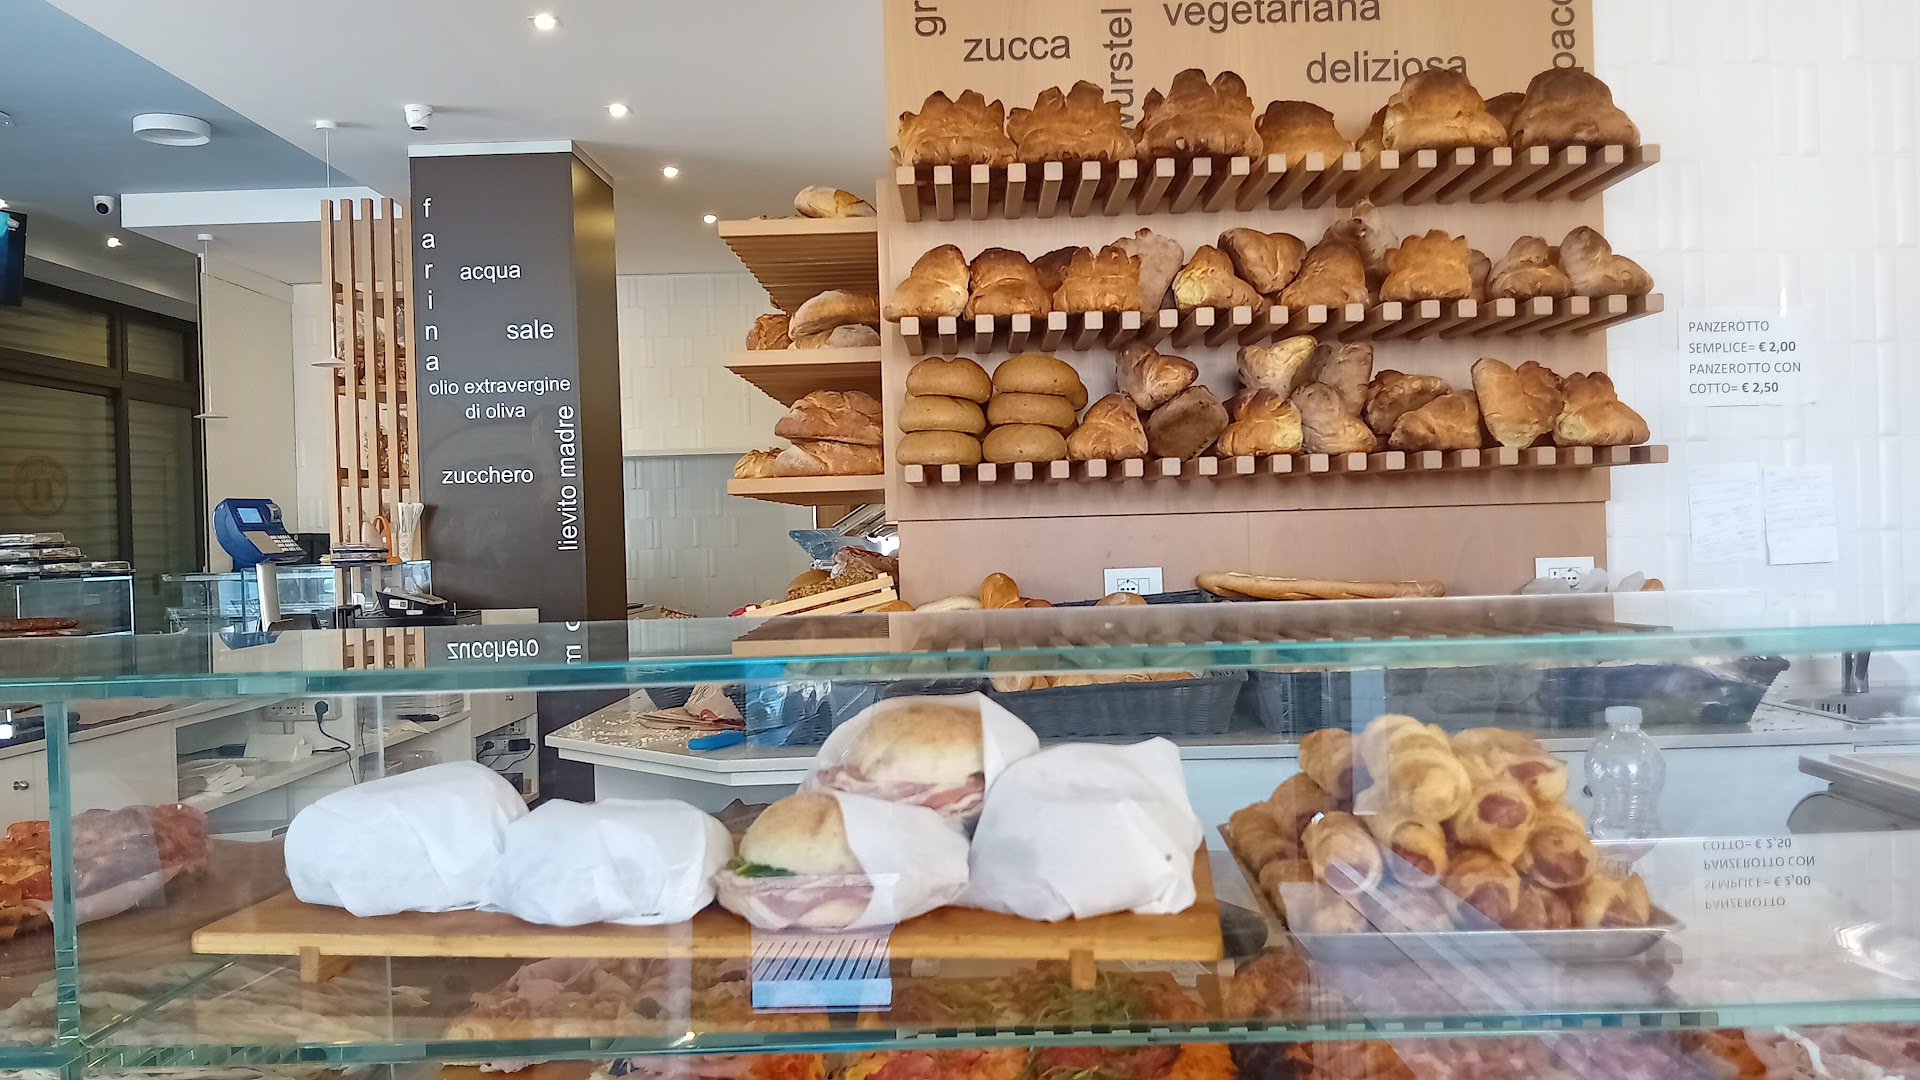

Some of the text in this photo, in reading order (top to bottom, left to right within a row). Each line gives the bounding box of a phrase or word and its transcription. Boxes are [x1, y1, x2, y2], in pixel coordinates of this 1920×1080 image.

[1163, 0, 1381, 34] vegetariana
[1550, 0, 1585, 72] pac
[963, 34, 1072, 63] zucca
[1306, 50, 1468, 84] deliziosa
[459, 264, 522, 283] acqua
[421, 197, 440, 371] farina
[506, 319, 555, 340] sale
[1688, 320, 1770, 333] PANZEROTTO
[1688, 340, 1796, 354] SEMPLICE= € 2,00
[1689, 362, 1801, 374] PANZEROTTO CON
[428, 376, 571, 396] olio extravergine
[1689, 382, 1779, 395] COTTO= € 2,50
[465, 403, 526, 420] di oliva
[441, 466, 534, 484] zucchero
[554, 405, 579, 551] lievito madre
